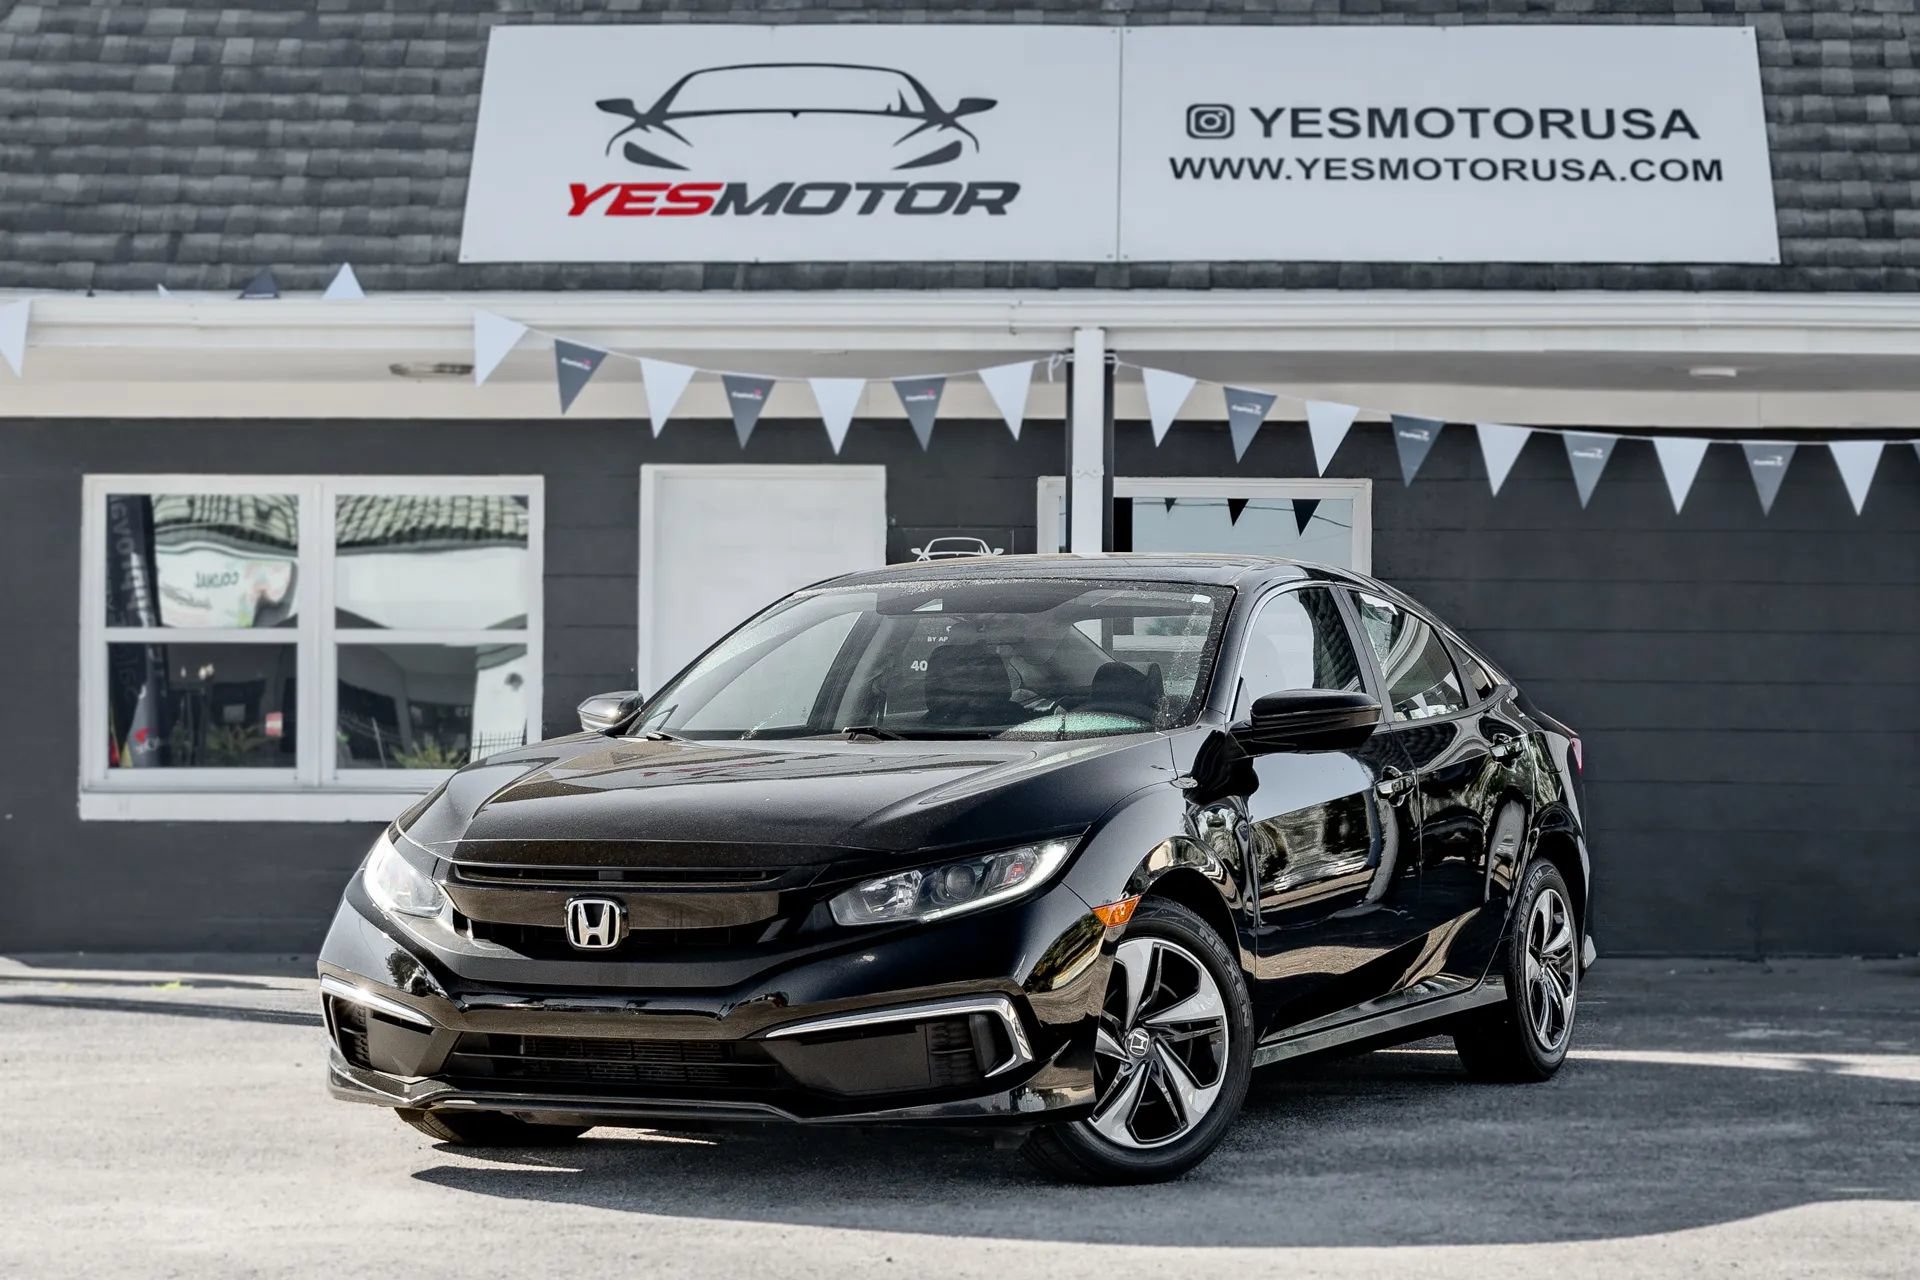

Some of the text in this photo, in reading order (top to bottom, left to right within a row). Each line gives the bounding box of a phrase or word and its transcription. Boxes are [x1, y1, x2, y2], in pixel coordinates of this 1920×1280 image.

[1250, 106, 1701, 141] YESMOTORUSA
[1168, 156, 1723, 182] WWW.YESMOTORUSA.COM
[568, 181, 1021, 217] YESMOTOR
[910, 660, 928, 671] 40
[1198, 927, 1250, 1028] NEXEN
